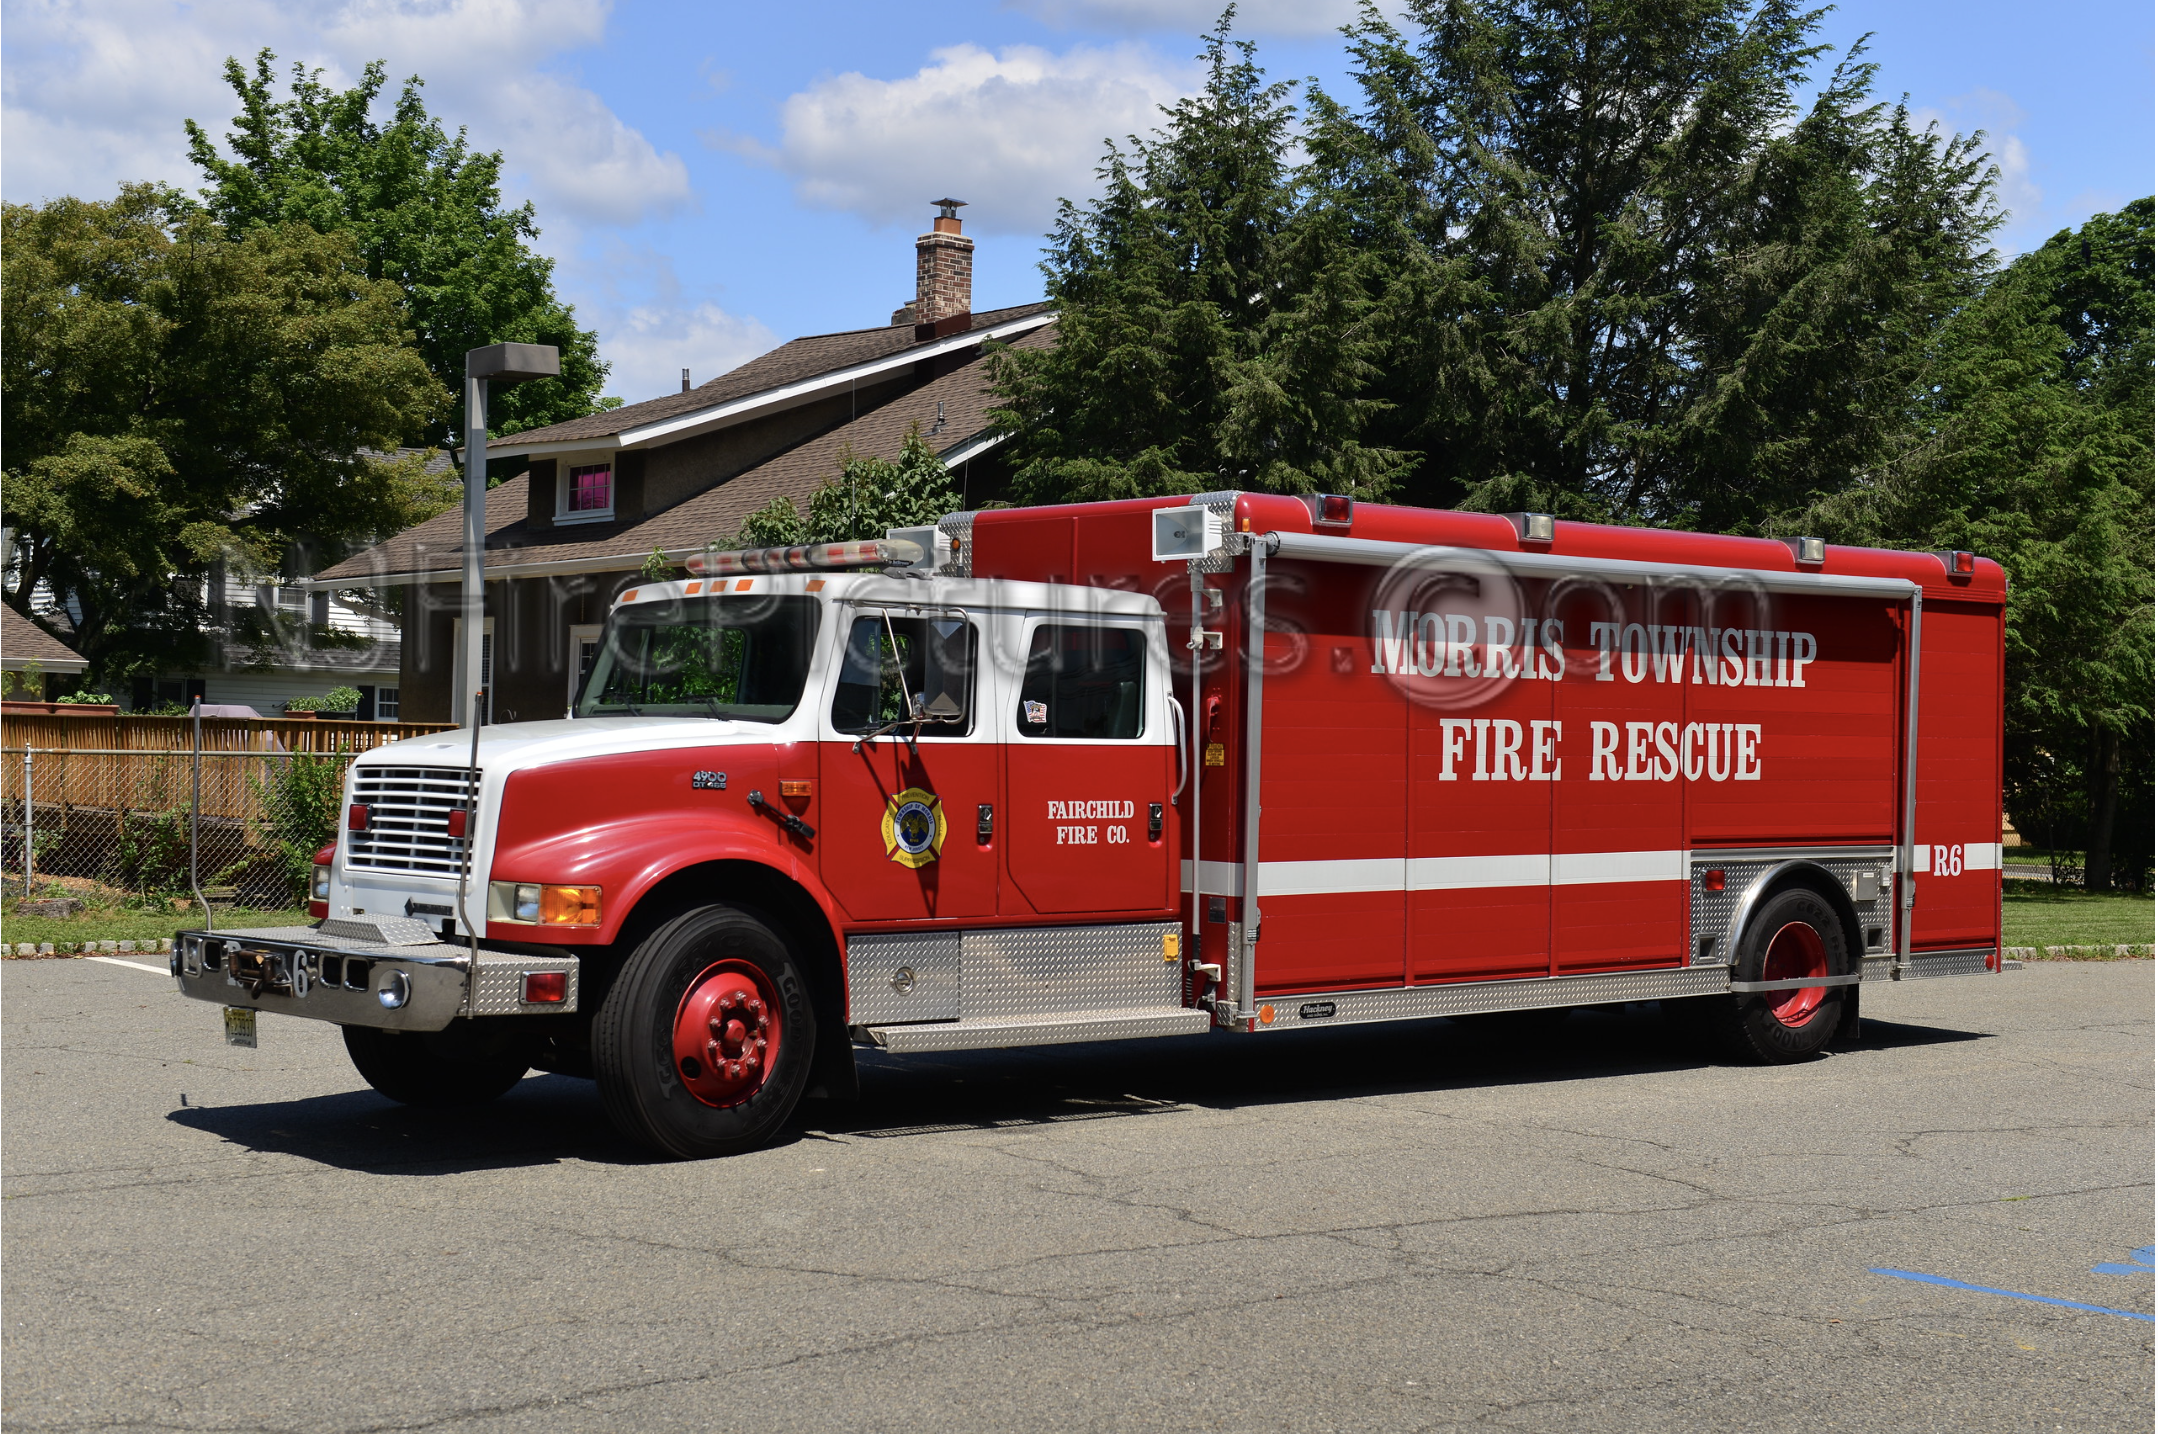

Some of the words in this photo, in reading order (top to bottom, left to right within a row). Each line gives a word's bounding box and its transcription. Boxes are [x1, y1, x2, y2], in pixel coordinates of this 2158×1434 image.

[1371, 609, 1566, 682] MORRIS
[1590, 621, 1818, 688] TOWNSHIP
[1439, 718, 1562, 781] FIRE
[1589, 721, 1762, 782] RESCUE
[693, 770, 727, 782] 4900
[902, 792, 930, 801] PREVENTION
[896, 803, 914, 824] TOWNSHIP
[922, 806, 934, 825] MORRIS
[1047, 800, 1135, 820] FAIRCHILD
[1056, 825, 1098, 845] FIRE
[1106, 825, 1131, 844] CO.
[1933, 844, 1962, 877] R6
[293, 949, 308, 998] 6
[1303, 1004, 1333, 1014] Hackney
